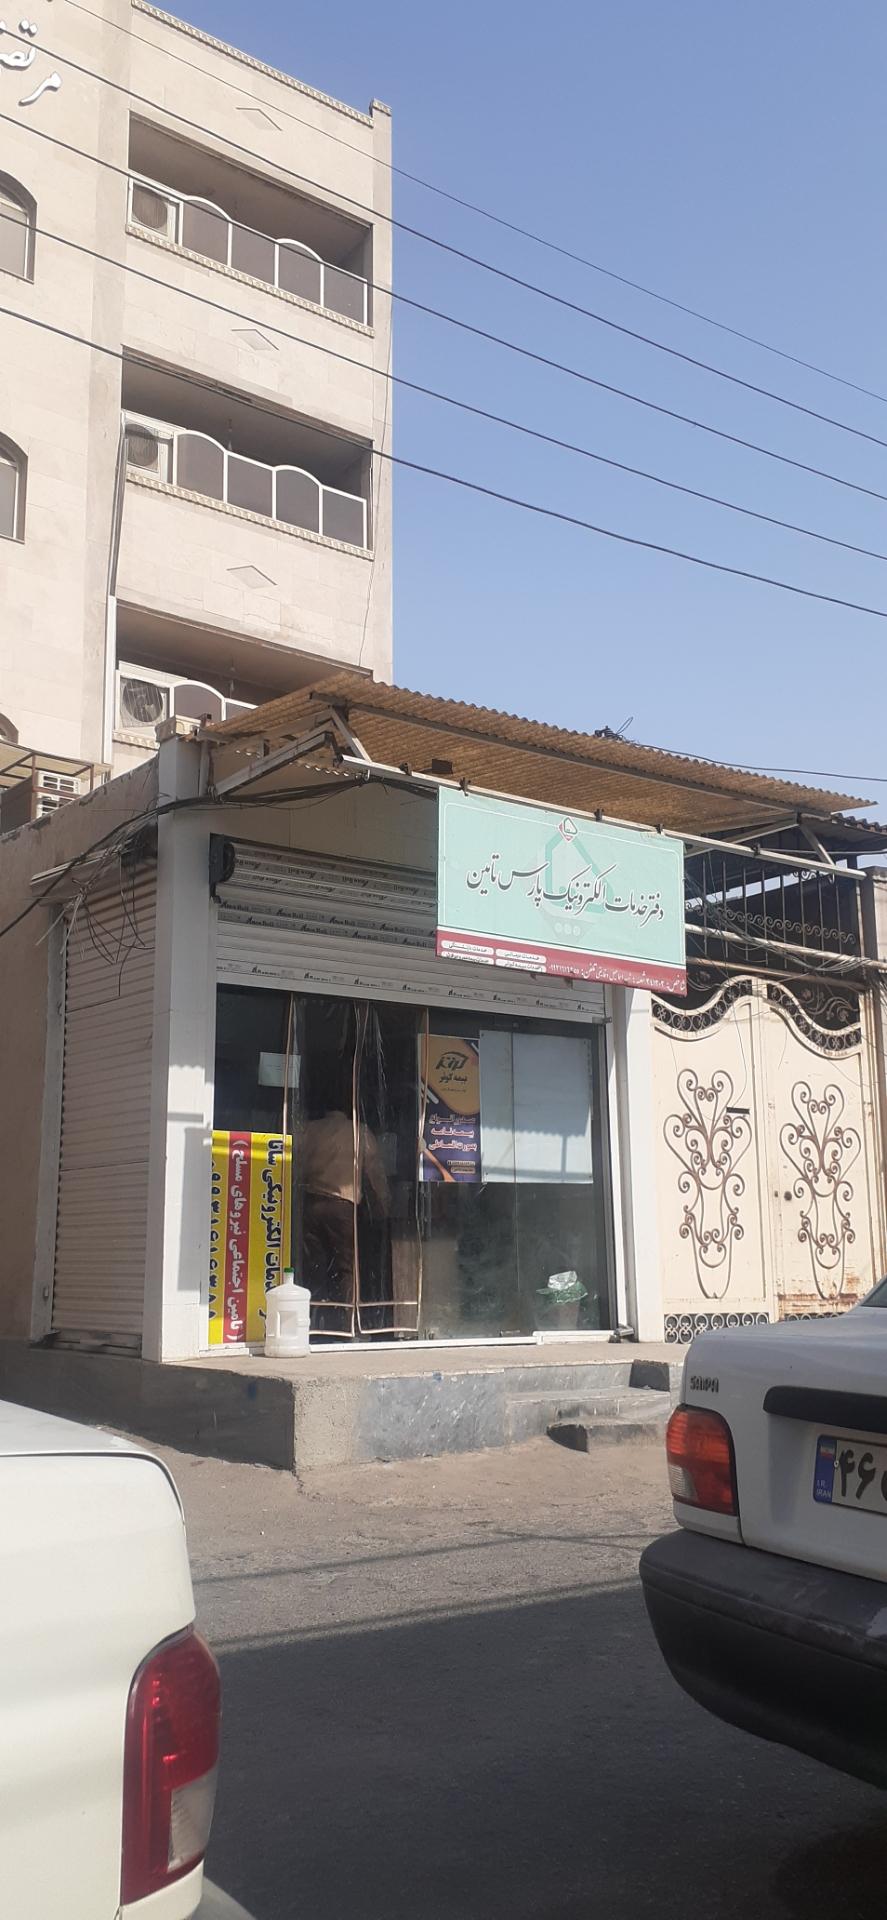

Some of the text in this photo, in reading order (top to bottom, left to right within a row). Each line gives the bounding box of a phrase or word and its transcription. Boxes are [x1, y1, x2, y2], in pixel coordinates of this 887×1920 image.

[498, 862, 549, 907] پارس
[543, 864, 617, 915] الکترونیک
[605, 891, 648, 915] خدمات
[641, 892, 664, 927] دفتر
[231, 1150, 248, 1182] مسلح
[228, 1239, 245, 1293] اجتماعی
[227, 1297, 244, 1330] تامین
